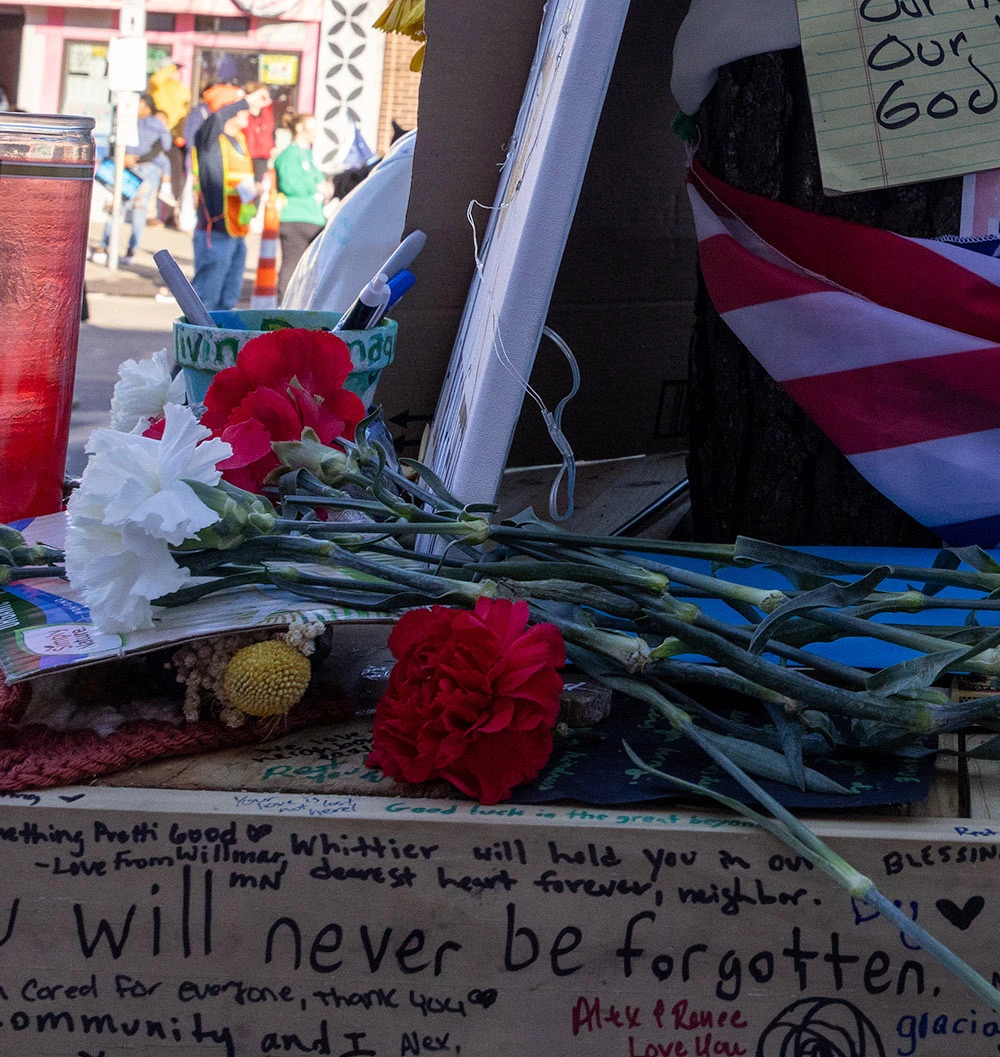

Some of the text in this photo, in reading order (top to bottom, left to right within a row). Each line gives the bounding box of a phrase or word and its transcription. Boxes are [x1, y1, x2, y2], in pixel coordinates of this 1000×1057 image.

[868, 32, 967, 71] Our
[875, 55, 999, 130] God
[169, 821, 238, 845] Good
[385, 802, 457, 815] Good
[470, 803, 525, 817] luck
[536, 810, 557, 819] in
[568, 809, 609, 822] the
[616, 814, 679, 824] great
[290, 833, 440, 860] Whittier
[473, 839, 527, 864] will
[548, 841, 622, 867] hold
[643, 848, 697, 882] you
[718, 850, 750, 869] in
[310, 857, 417, 887] dearest
[437, 866, 518, 891] heart
[534, 870, 663, 906] forever,
[73, 864, 213, 959] will
[264, 915, 462, 977] never
[504, 902, 586, 977] be
[616, 910, 941, 1001] forgotten.
[0, 1011, 236, 1057] ommunity
[261, 1020, 331, 1055] and
